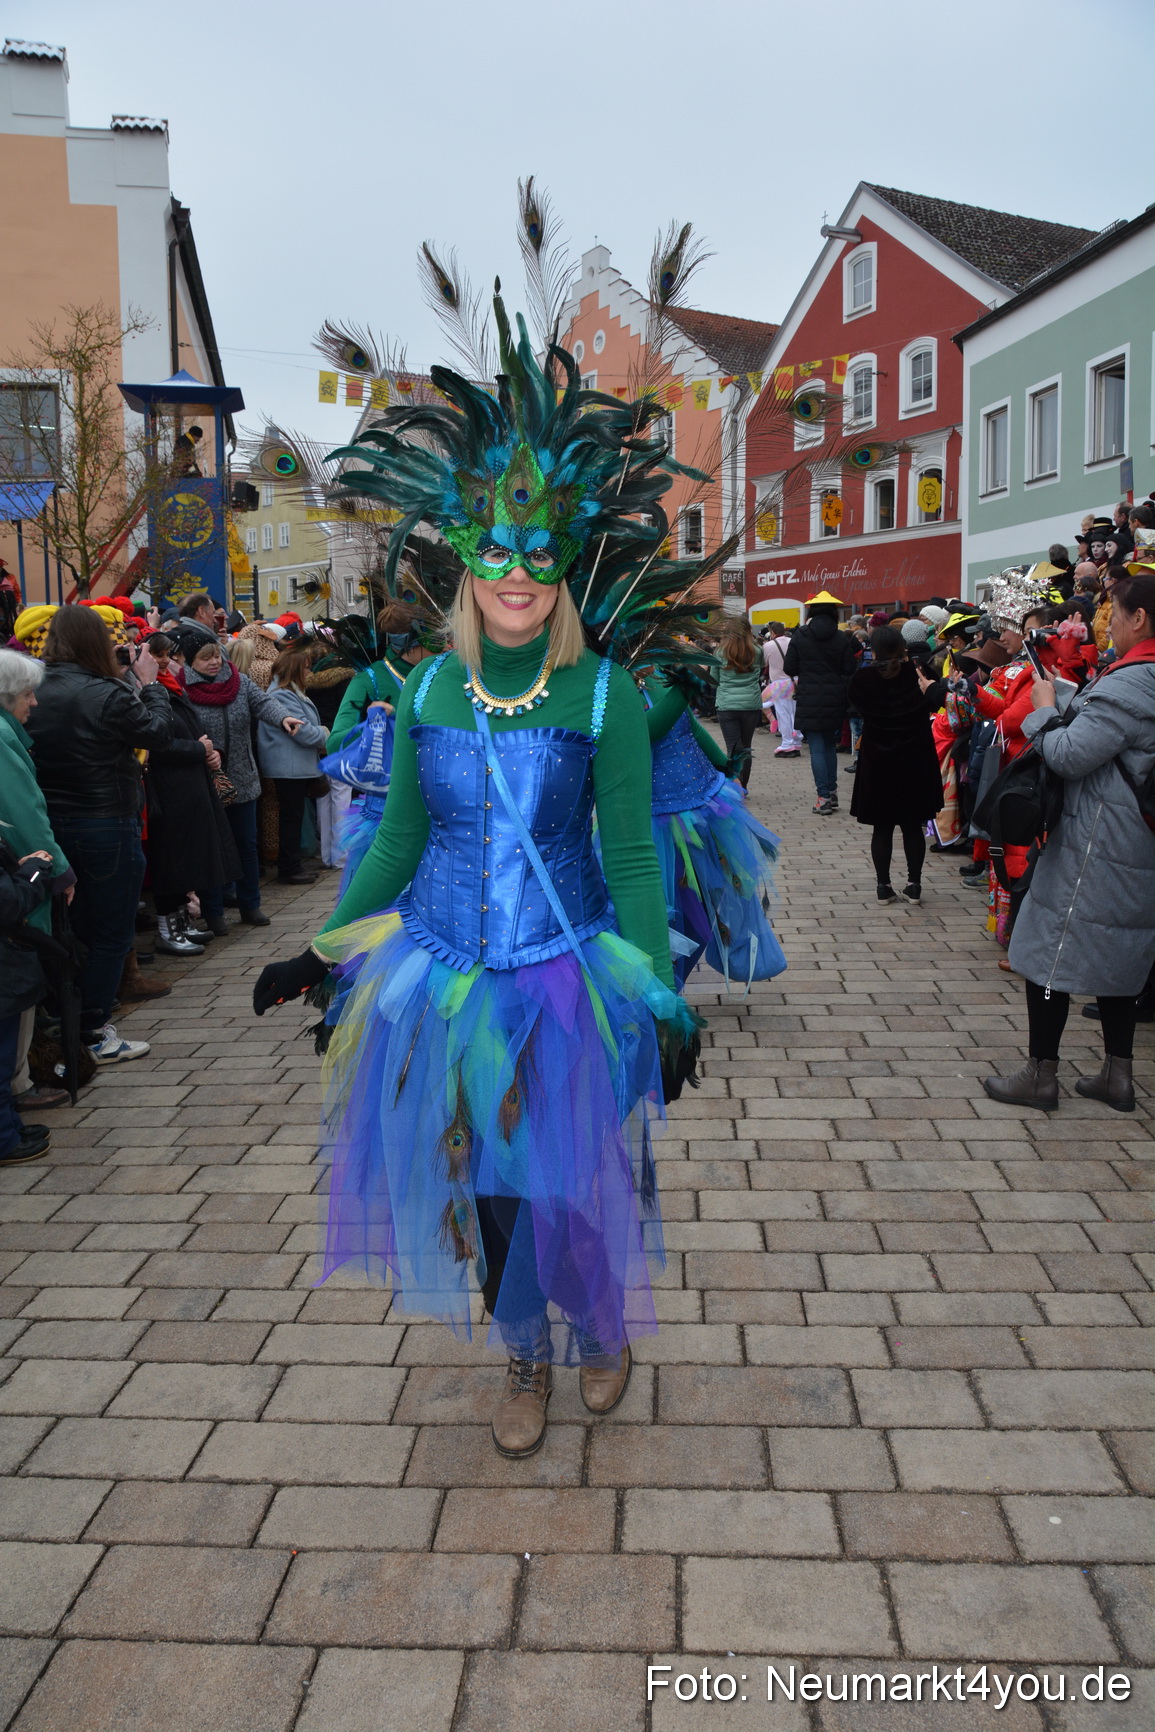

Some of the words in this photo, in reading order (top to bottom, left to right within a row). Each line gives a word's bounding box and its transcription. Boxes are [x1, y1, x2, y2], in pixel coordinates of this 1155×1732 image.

[801, 564, 819, 583] Mode
[820, 568, 840, 586] Genuss
[842, 558, 867, 578] Erlebnis
[881, 557, 926, 588] Erlebnis
